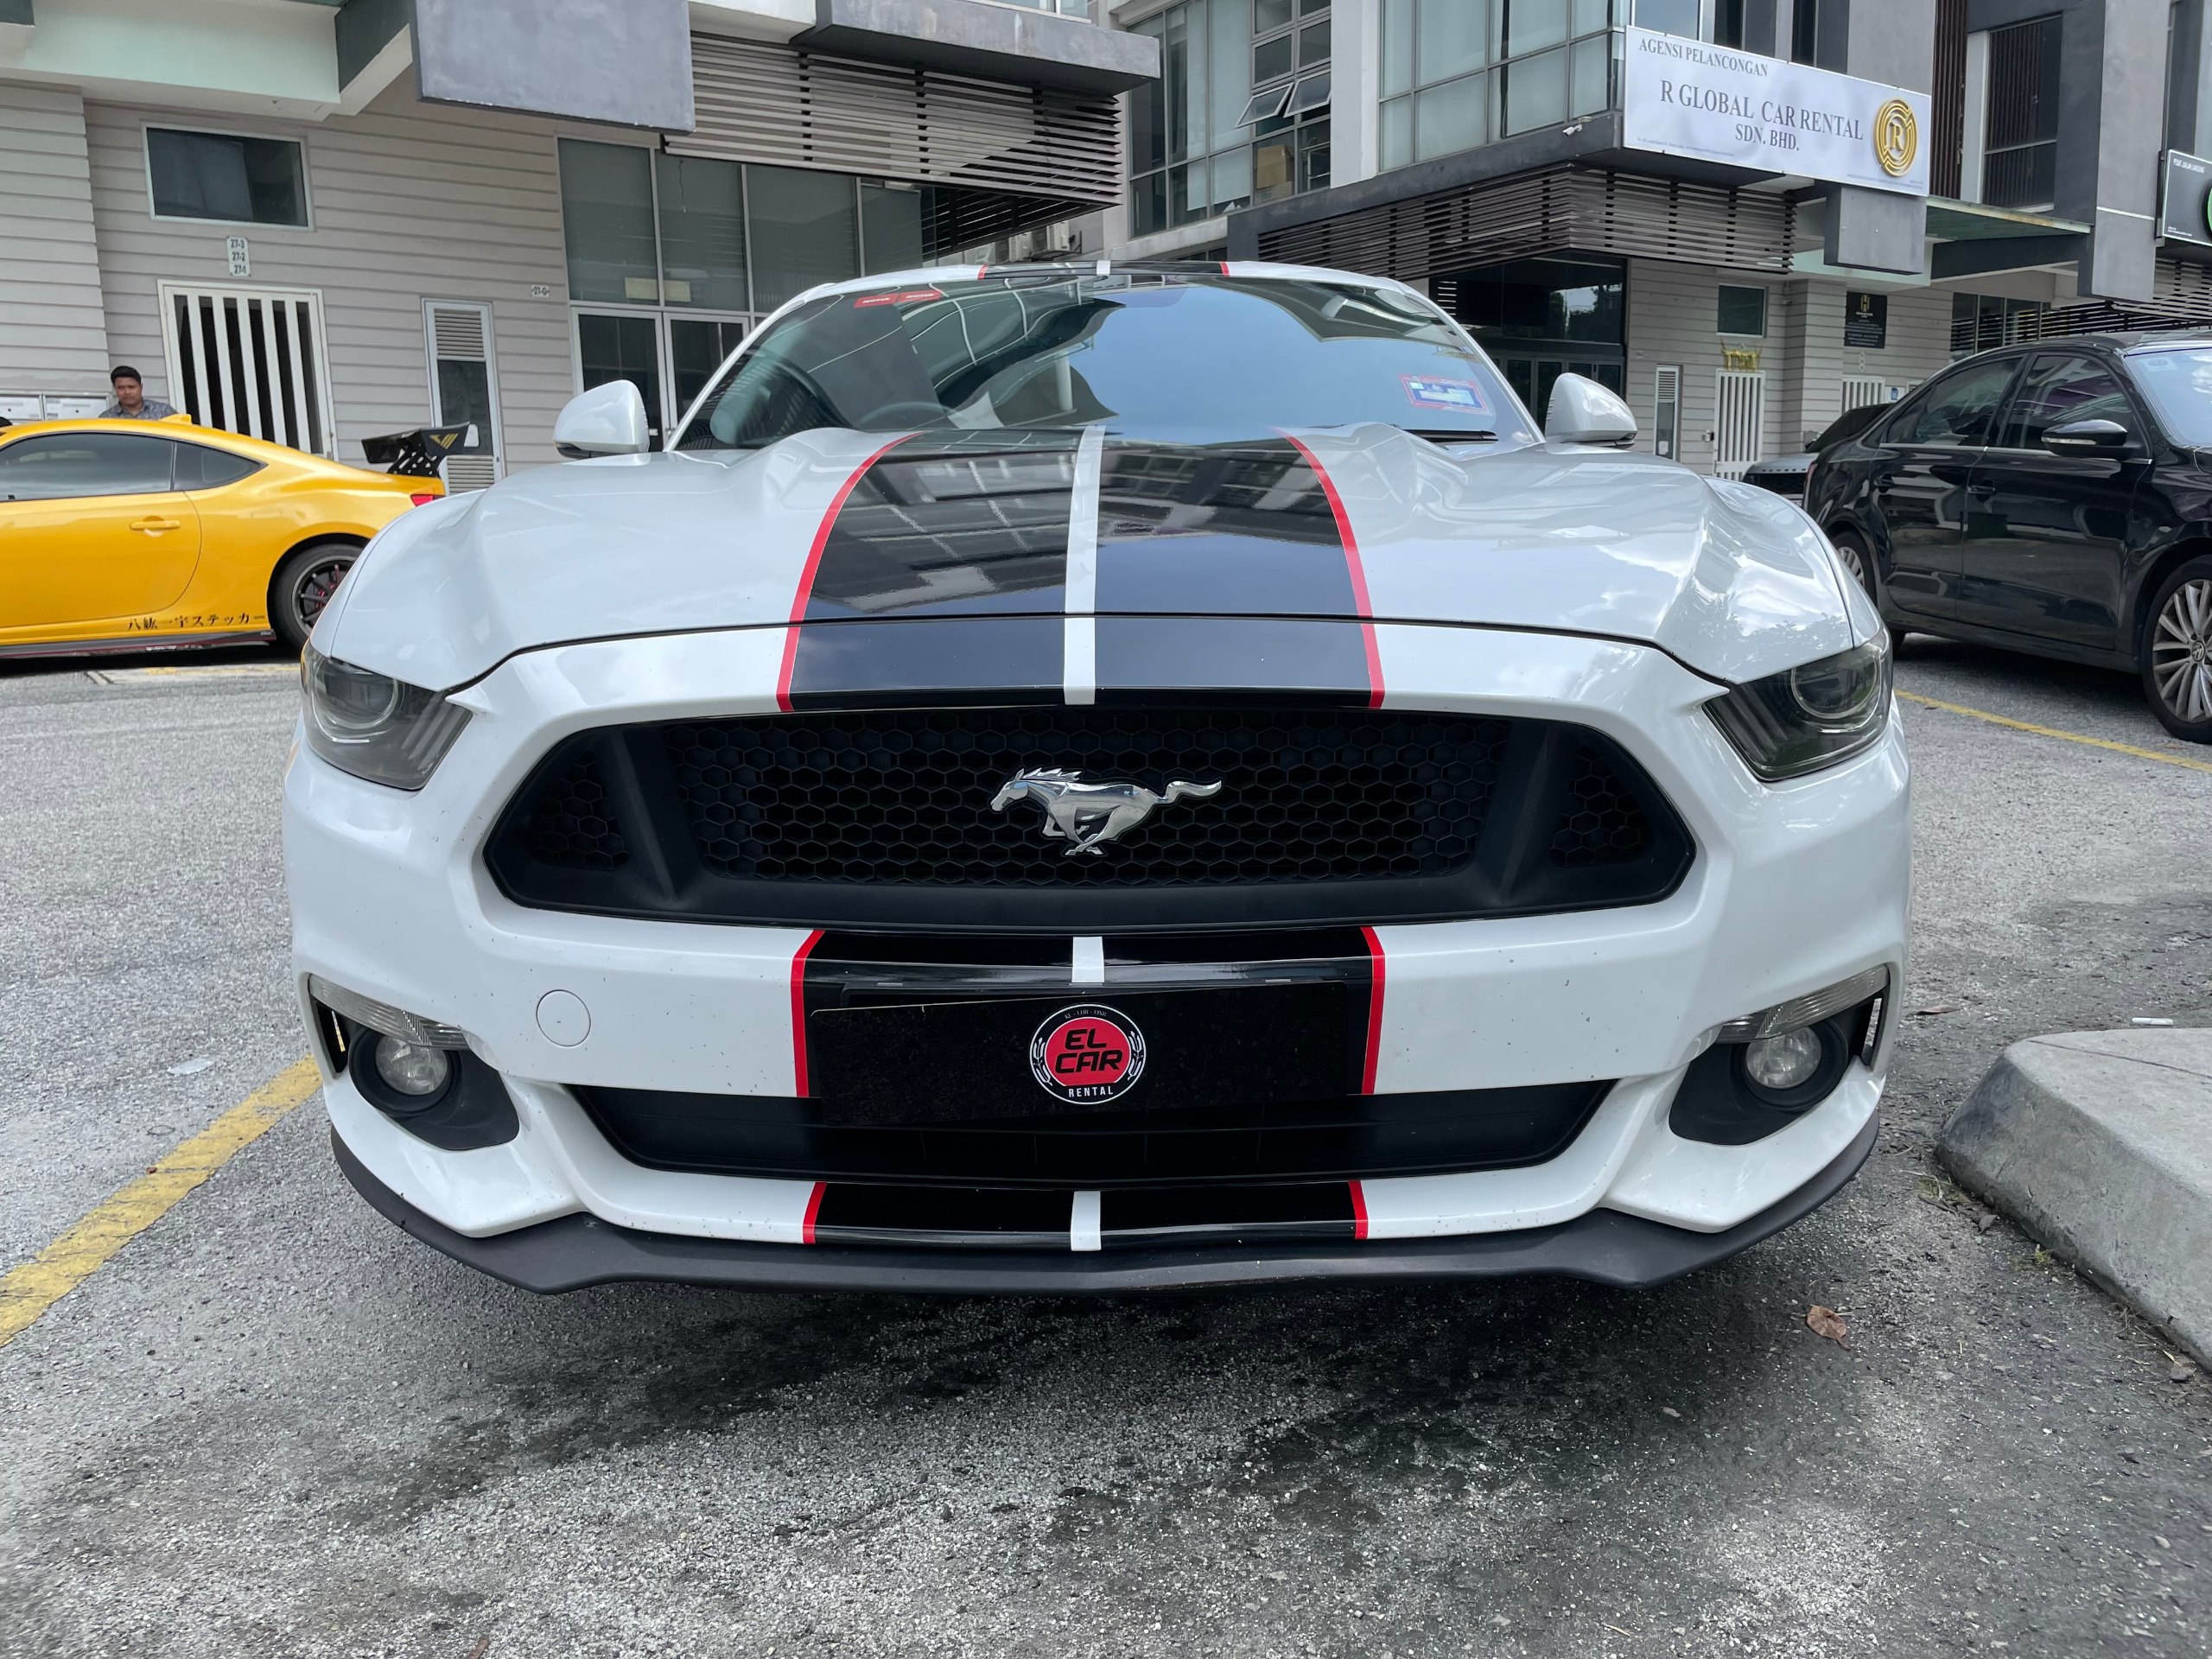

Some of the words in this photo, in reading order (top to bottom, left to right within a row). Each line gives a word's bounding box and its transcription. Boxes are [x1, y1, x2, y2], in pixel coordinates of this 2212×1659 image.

[1639, 38, 1683, 60] AGENSI
[1685, 47, 1768, 77] PELANCONGAN
[1661, 79, 1674, 103] R
[1679, 84, 1754, 119] GLOBAL
[1762, 100, 1796, 128] CAR
[1801, 110, 1864, 141] RENTAL
[1735, 124, 1766, 145] SDN.
[1770, 130, 1800, 151] BHD.
[1065, 1027, 1107, 1050] EL
[1055, 1049, 1123, 1074] CAR
[1068, 1085, 1113, 1098] RENTAL
